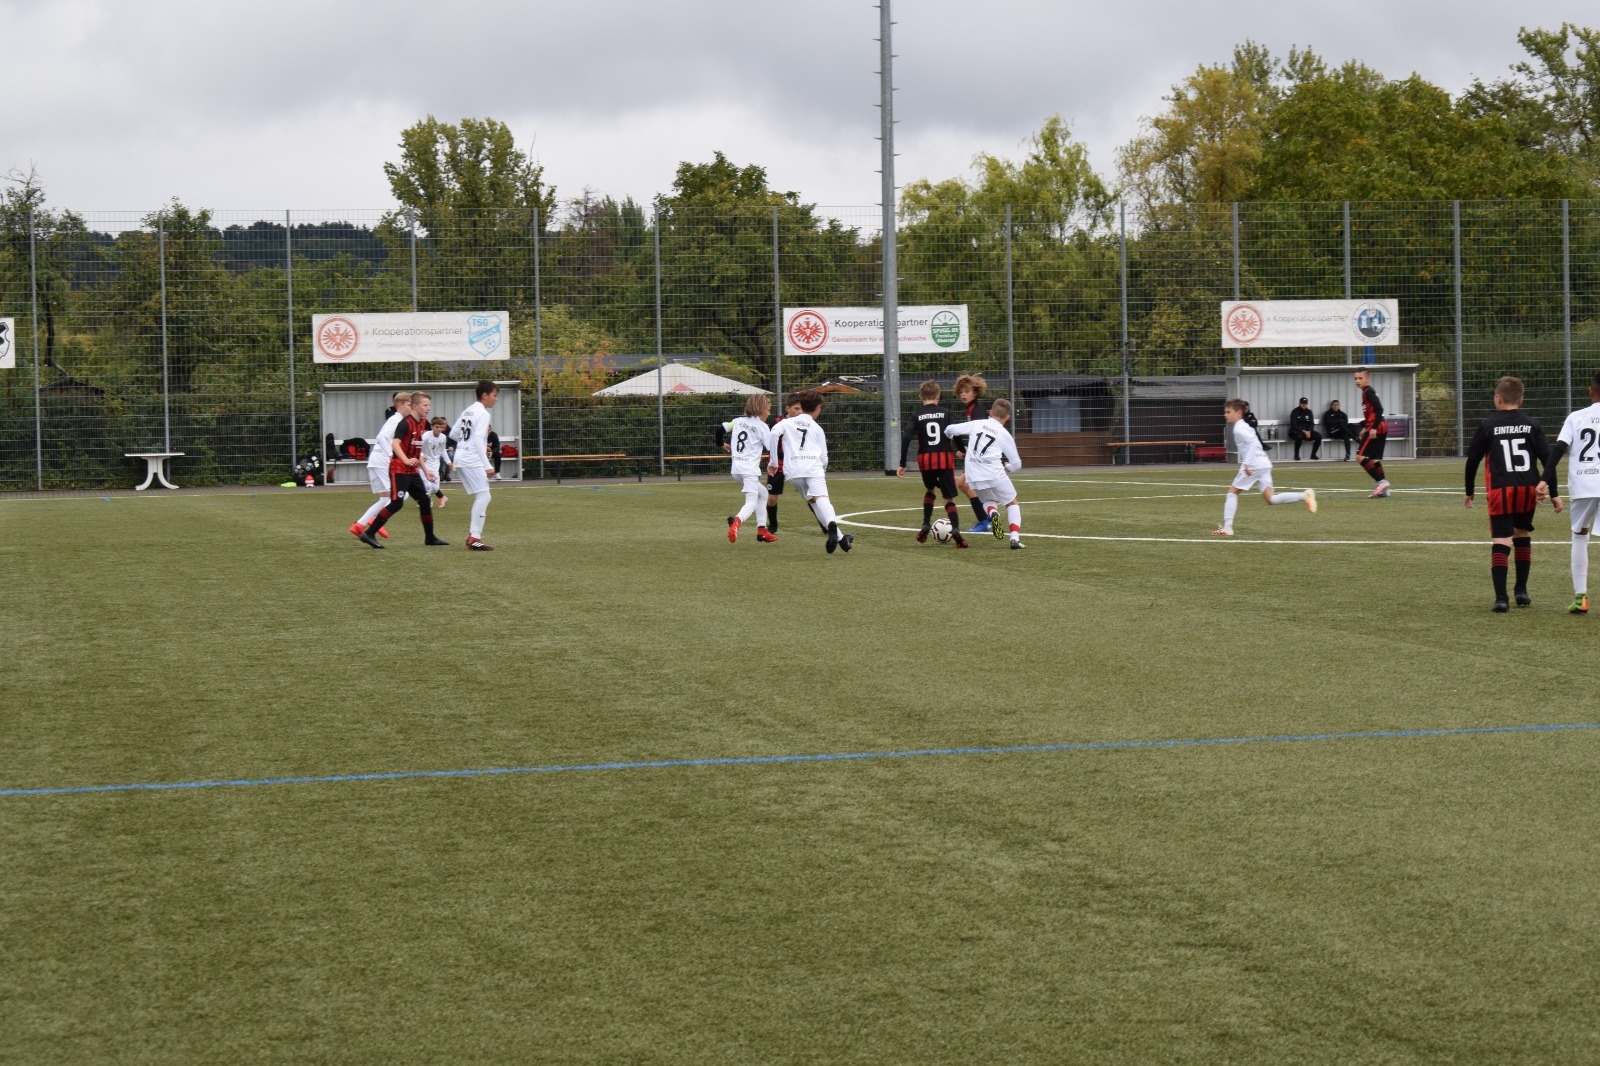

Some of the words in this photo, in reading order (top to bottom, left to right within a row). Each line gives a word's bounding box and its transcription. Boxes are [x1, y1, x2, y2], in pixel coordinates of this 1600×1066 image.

[471, 318, 489, 327] TSG
[1273, 315, 1348, 323] Kooperationspartner
[372, 327, 463, 337] Kooperationspartner
[736, 430, 748, 453] 8
[796, 427, 808, 451] 7
[926, 422, 940, 446] 9
[1493, 424, 1532, 436] EINTRACHT
[973, 431, 996, 457] 17
[1499, 438, 1531, 472] 15
[1578, 427, 1600, 463] 2
